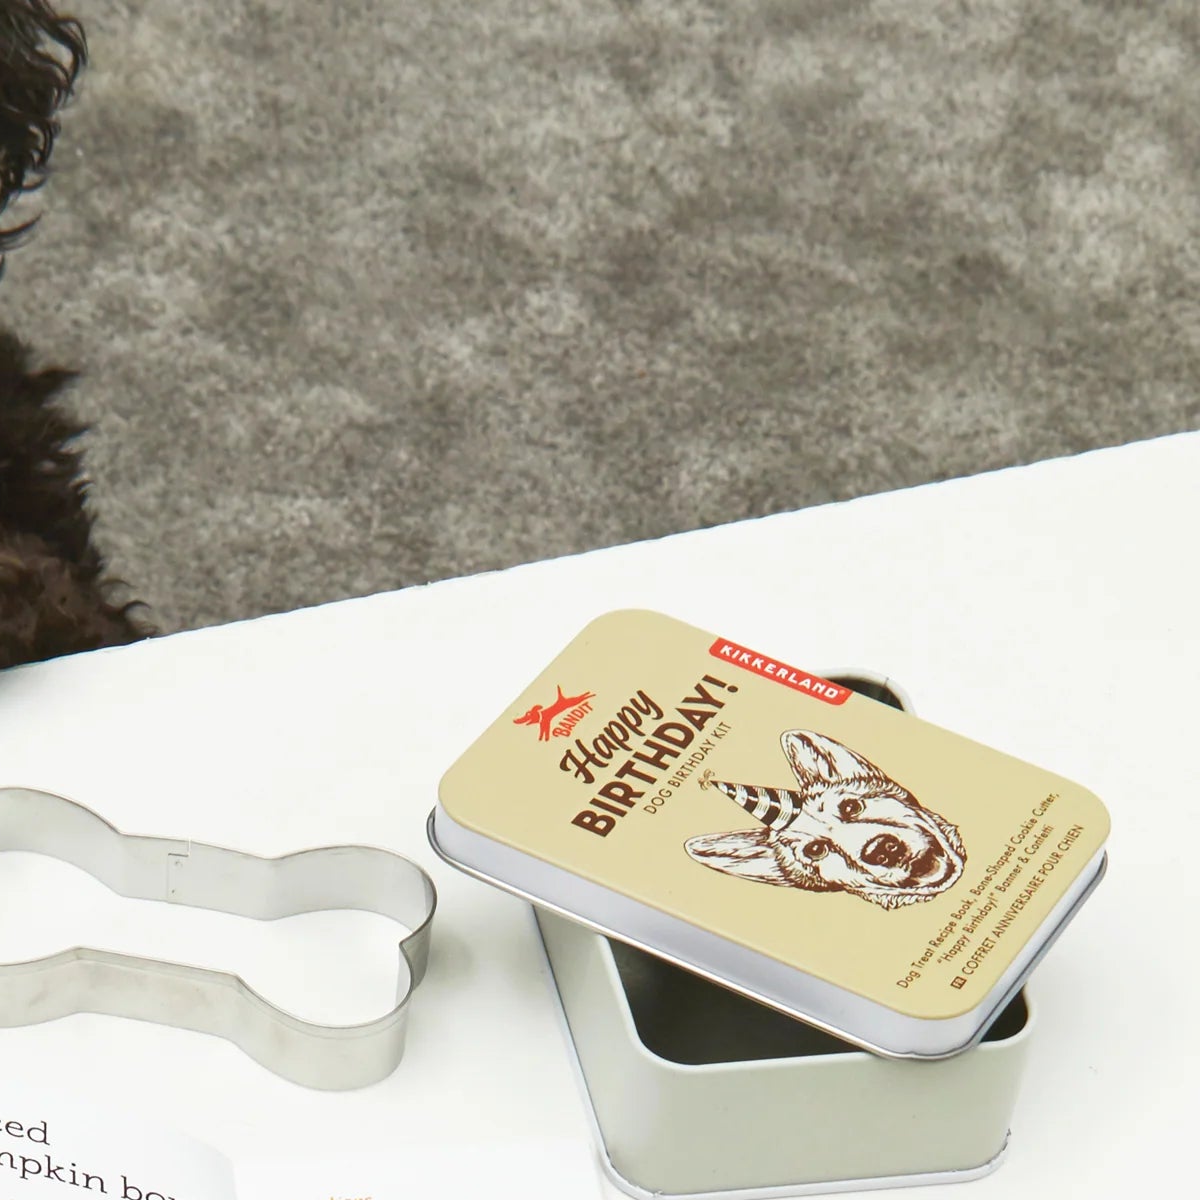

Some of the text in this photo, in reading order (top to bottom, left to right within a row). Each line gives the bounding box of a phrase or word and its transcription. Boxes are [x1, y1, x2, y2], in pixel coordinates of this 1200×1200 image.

[552, 702, 594, 738] BANDIT
[558, 690, 664, 784] Happy
[570, 674, 738, 838] BIRTHDAY!
[644, 721, 732, 816] DOG BIRTHDAY KIT
[896, 969, 921, 989] Dog
[911, 948, 936, 969] Treat
[928, 921, 957, 948] Recipe
[970, 844, 1016, 896] Bone-Shaped
[1010, 818, 1038, 845] Cookie
[961, 824, 1084, 975] COFFRET ANNIVERSAIRE POUR CHIEN
[994, 864, 1023, 893] Banner
[1017, 856, 1031, 864] &
[1024, 824, 1054, 855] Confetti
